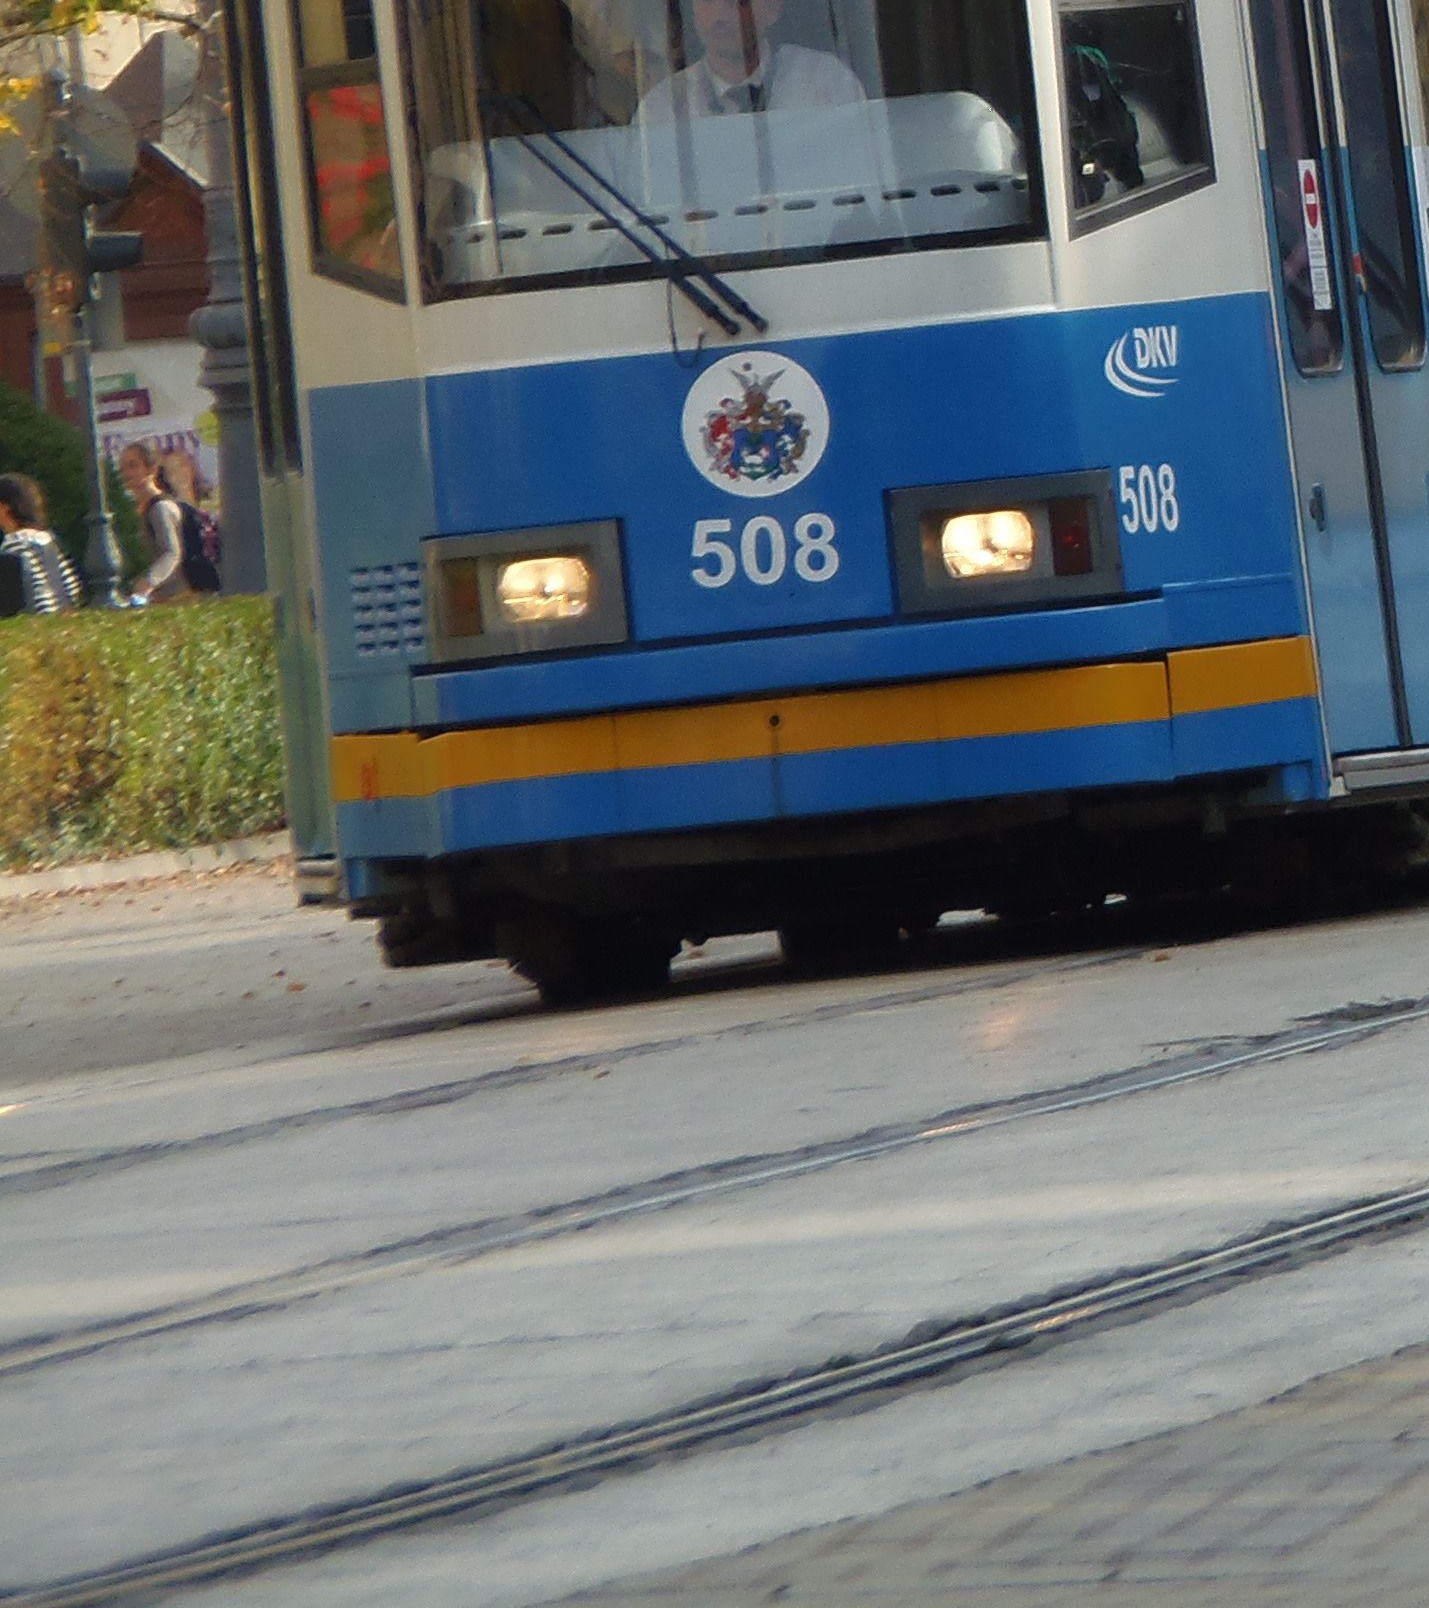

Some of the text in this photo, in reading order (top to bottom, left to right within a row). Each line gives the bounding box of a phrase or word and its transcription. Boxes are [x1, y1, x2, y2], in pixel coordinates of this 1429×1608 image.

[1132, 325, 1178, 369] DKV
[1119, 463, 1180, 534] 508
[691, 512, 840, 588] 508
